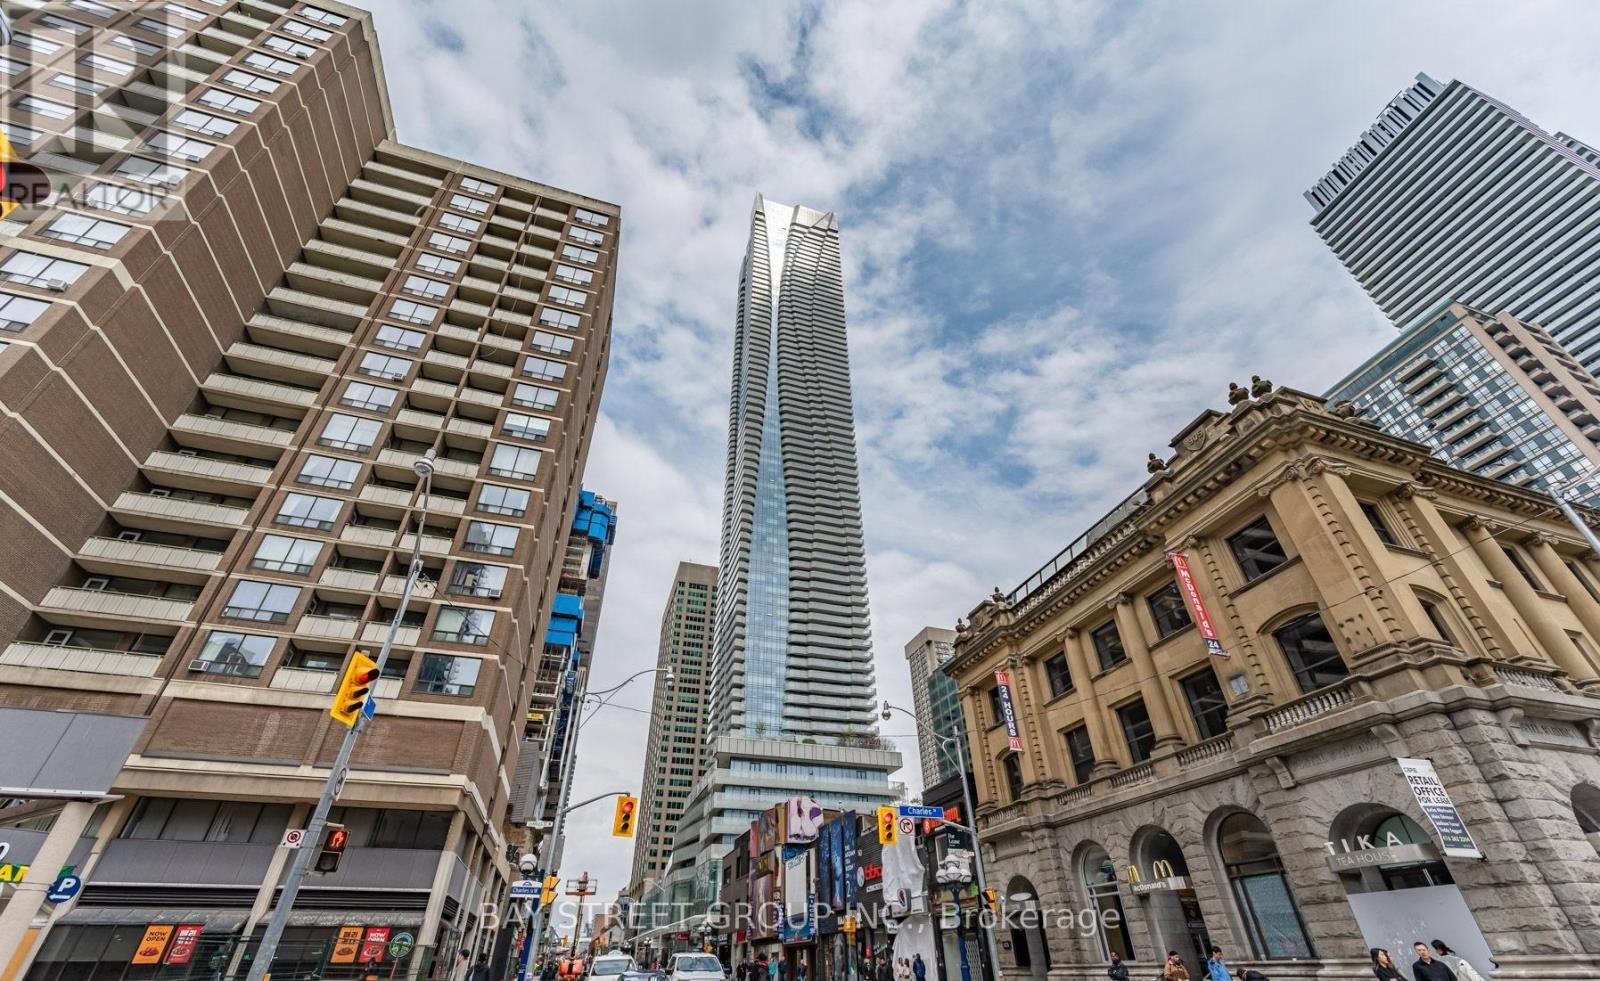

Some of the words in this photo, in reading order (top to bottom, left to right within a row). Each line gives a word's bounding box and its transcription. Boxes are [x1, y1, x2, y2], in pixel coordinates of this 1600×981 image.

[1004, 702, 1017, 736] HOURS
[1413, 786, 1445, 797] OFFICE
[907, 807, 933, 816] Charles
[1324, 831, 1404, 855] TIKA
[1336, 856, 1355, 866] TEA
[1357, 850, 1393, 863] HOUS
[58, 878, 76, 892] P
